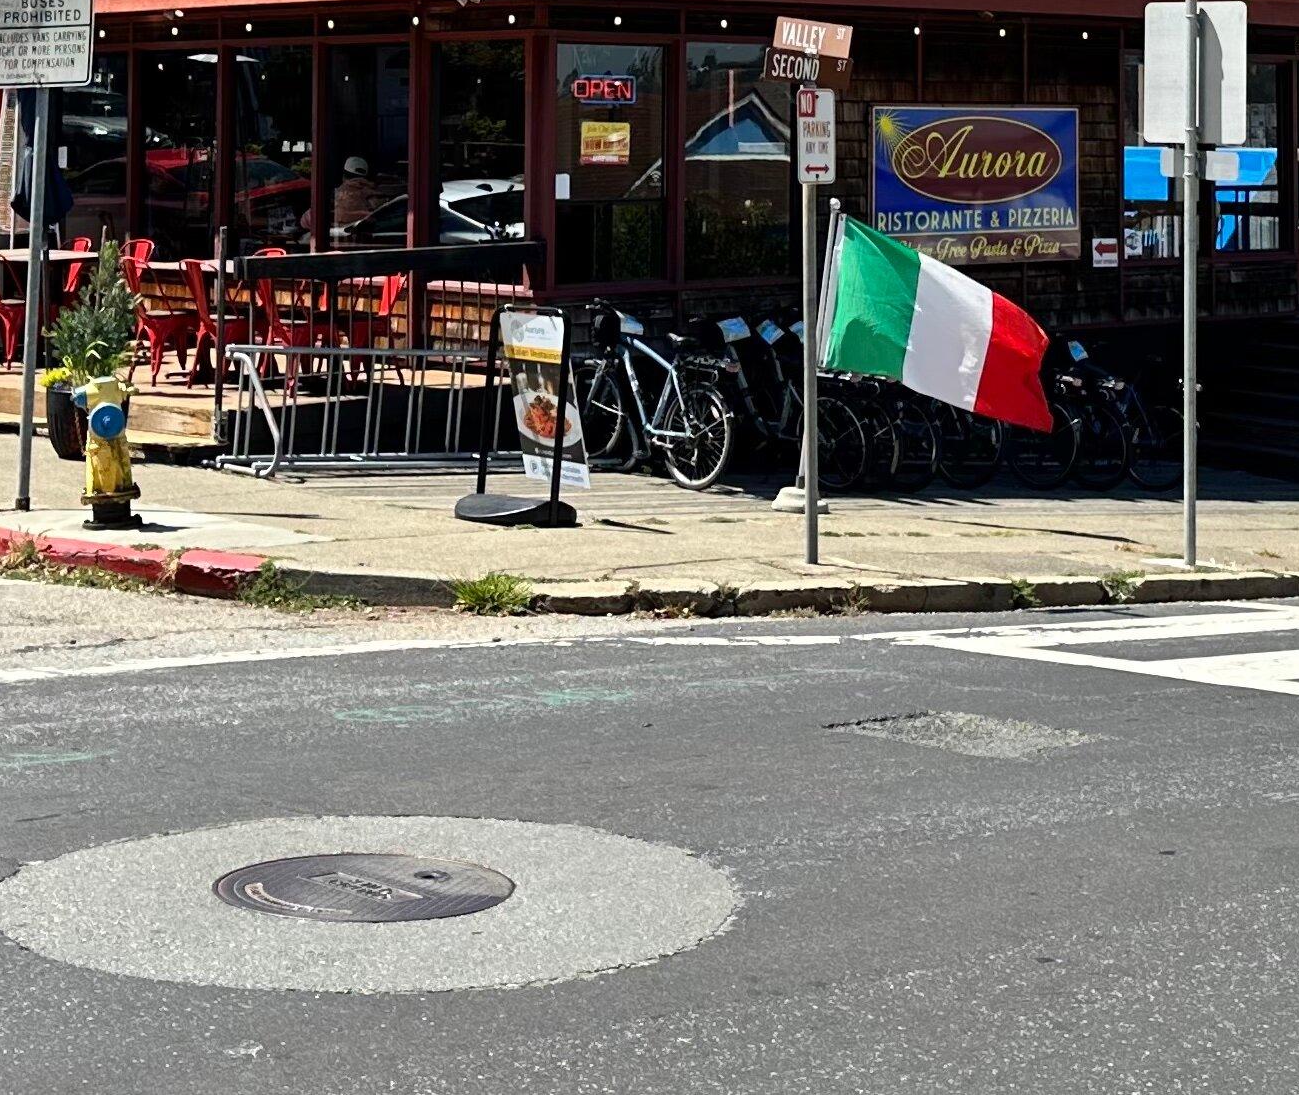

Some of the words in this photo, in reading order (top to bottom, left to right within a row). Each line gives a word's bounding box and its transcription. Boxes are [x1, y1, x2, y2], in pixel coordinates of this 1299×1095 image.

[4, 9, 82, 24] PROHIBITED
[32, 31, 50, 43] VANS
[53, 29, 87, 43] CARRYING
[782, 21, 826, 50] VALLEY
[836, 27, 846, 40] ST
[18, 45, 28, 57] OR
[31, 45, 51, 57] MORE
[54, 44, 86, 55] PERSONS
[4, 59, 19, 71] FOR
[21, 57, 75, 70] COMPENSATION
[771, 53, 820, 81] SECOND
[836, 59, 848, 72] ST
[574, 79, 631, 99] OPEN
[800, 93, 813, 114] NO
[803, 120, 830, 138] PARKING
[805, 141, 815, 154] ANY
[817, 141, 829, 154] TIME
[902, 125, 1053, 179] Aurora
[877, 209, 983, 232] RISTORANTE
[990, 211, 1000, 228] &
[1008, 207, 1075, 227] PIZZERIA
[936, 237, 968, 260] Free
[970, 235, 1008, 260] Pasta
[1010, 237, 1023, 256] &
[1024, 234, 1060, 257] Pizza
